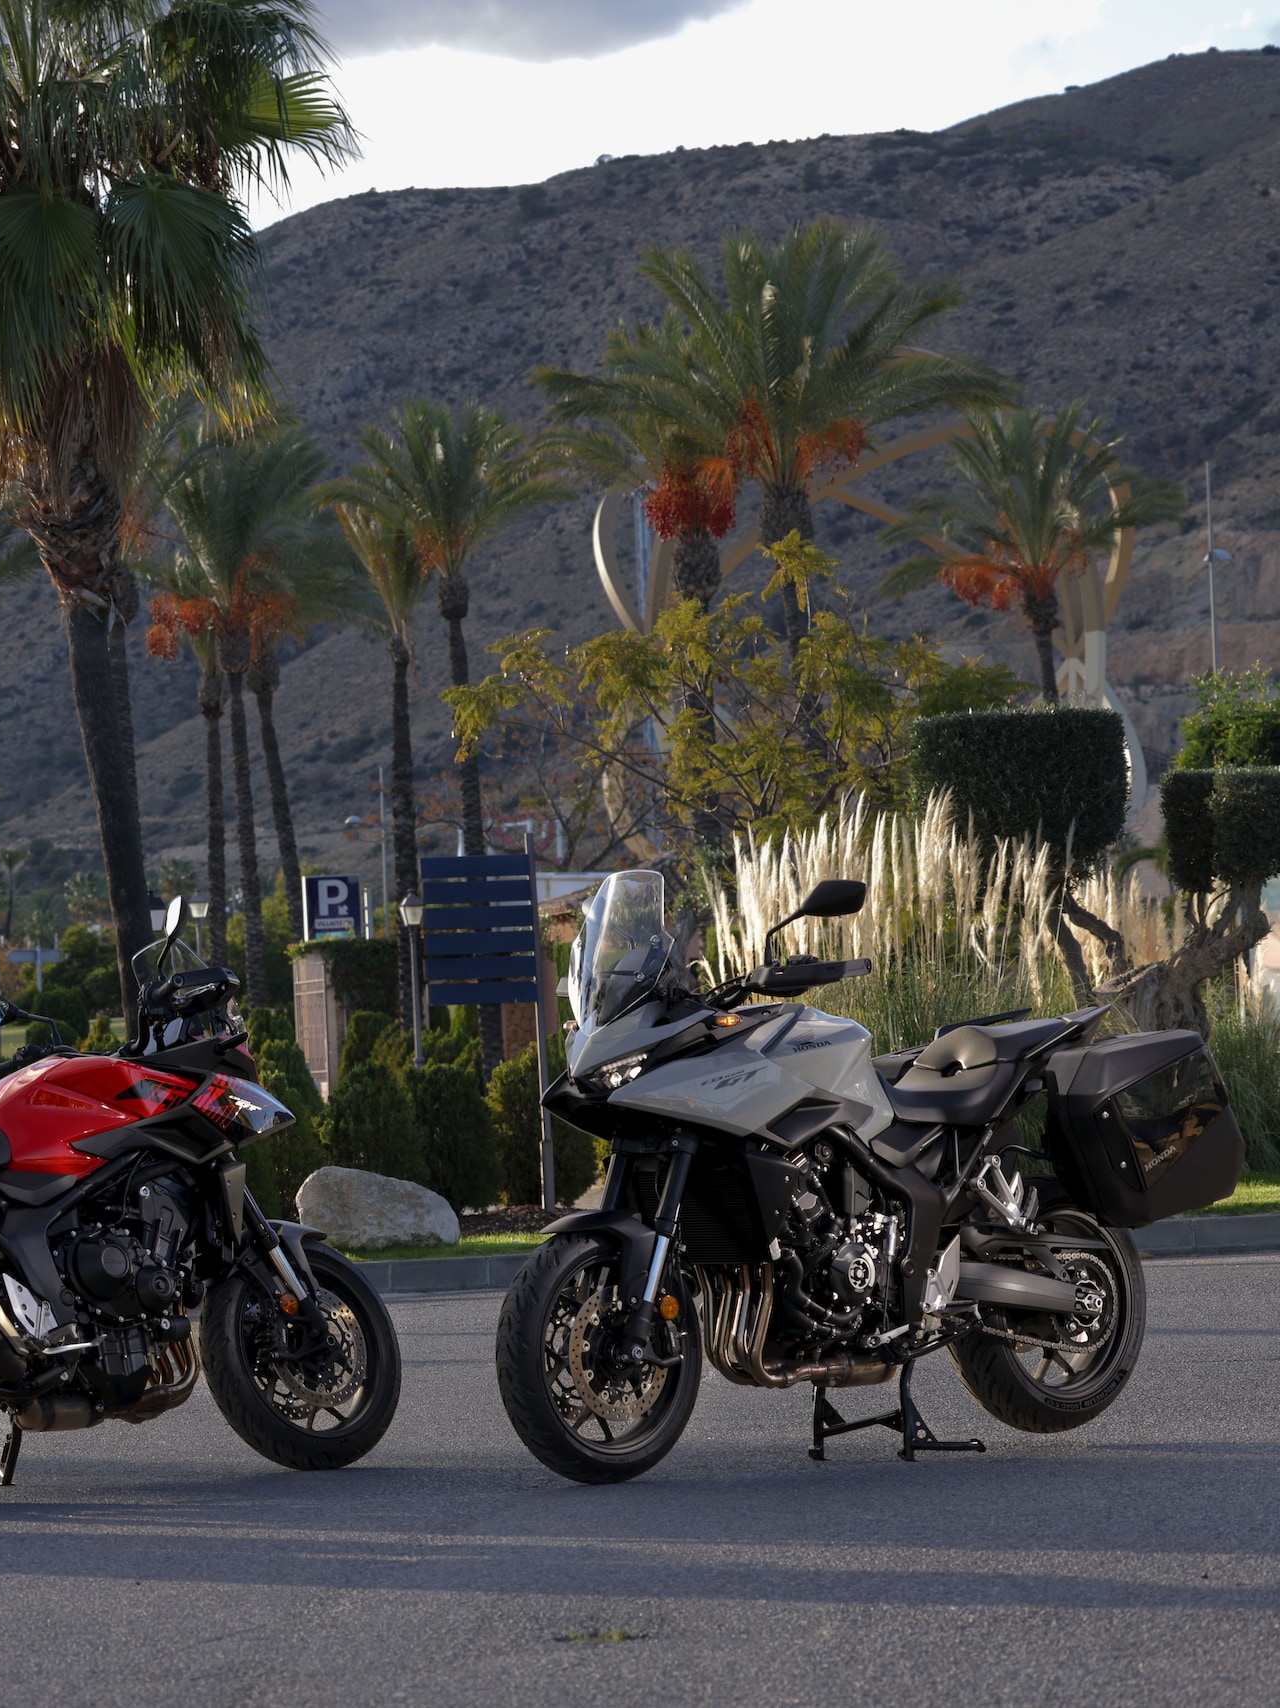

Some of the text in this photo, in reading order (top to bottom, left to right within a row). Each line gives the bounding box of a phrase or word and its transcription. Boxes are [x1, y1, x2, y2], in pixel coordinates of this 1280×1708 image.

[317, 879, 349, 916] P
[792, 1040, 832, 1053] HONDA
[1144, 1145, 1177, 1172] HONDA
[1083, 1380, 1117, 1407] MICHELIN
